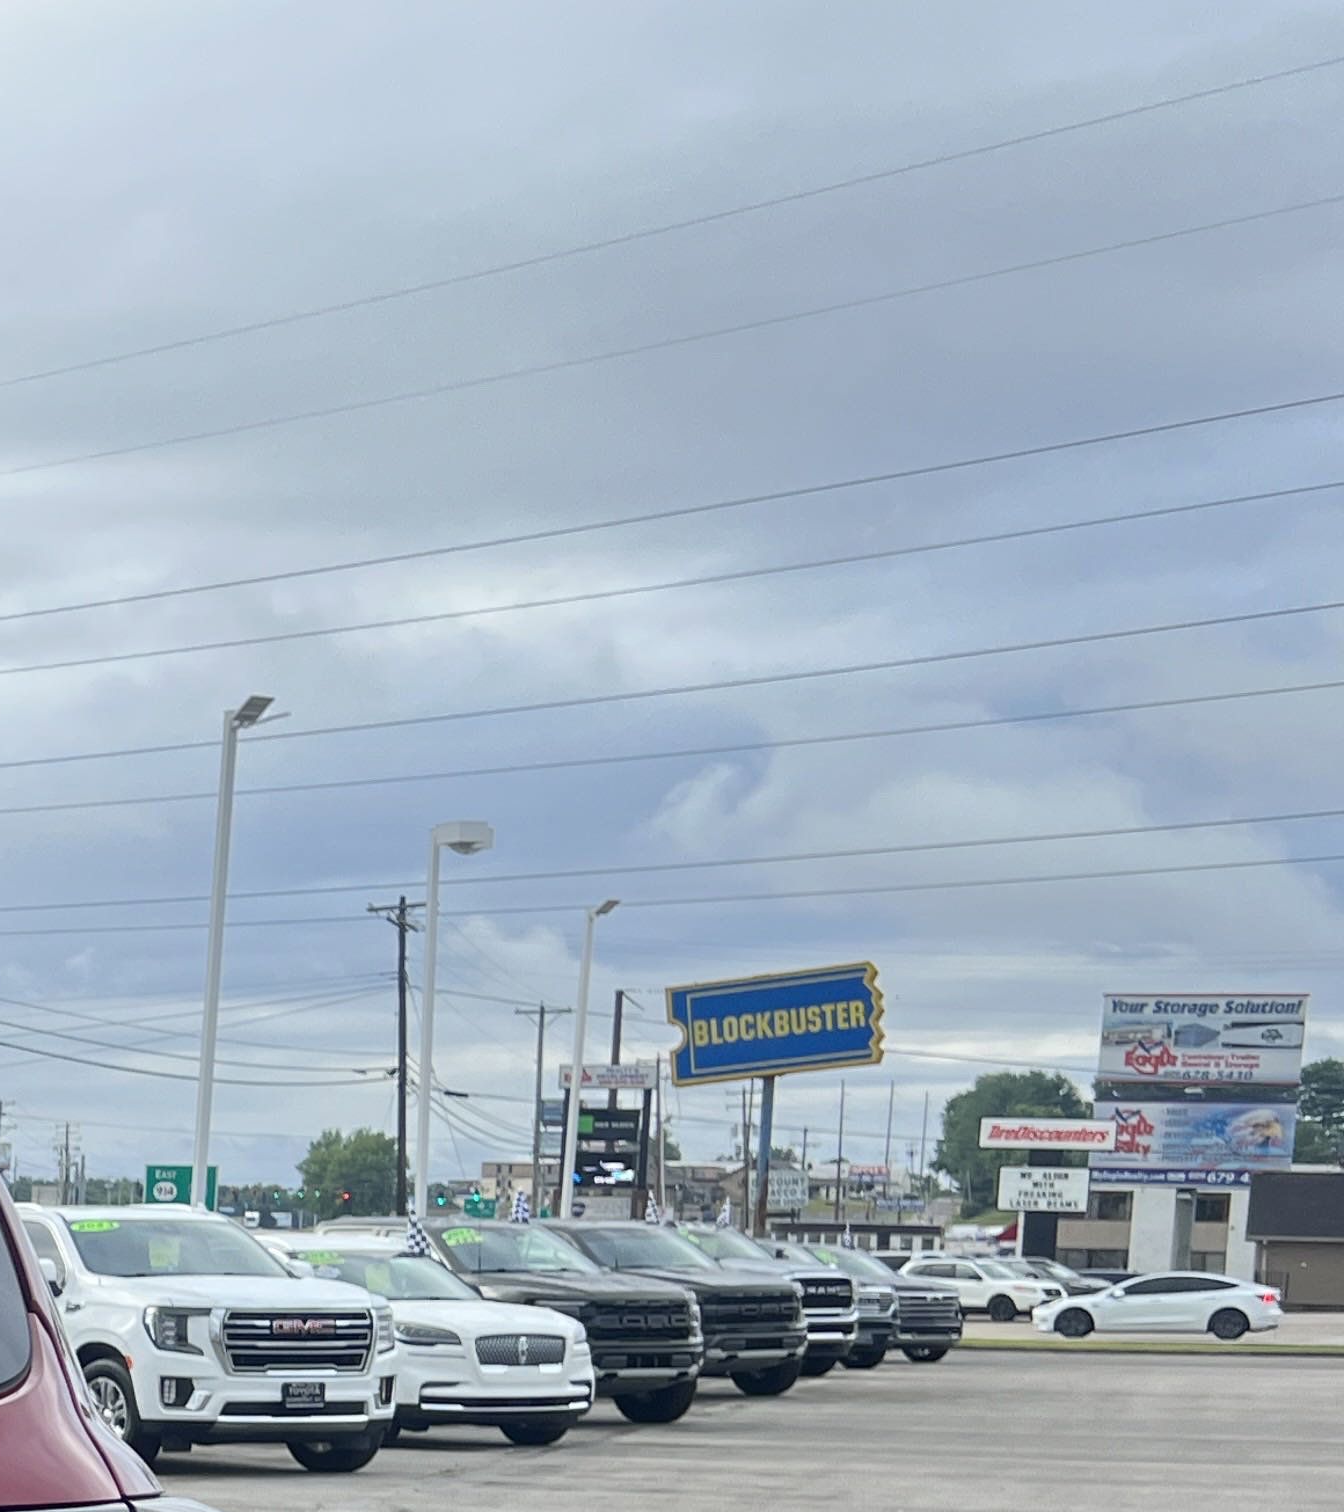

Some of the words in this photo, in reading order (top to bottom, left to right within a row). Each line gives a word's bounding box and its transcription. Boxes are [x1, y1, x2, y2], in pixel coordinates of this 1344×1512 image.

[1112, 1000, 1148, 1014] Your
[1153, 1000, 1220, 1017] Storage
[1223, 1000, 1302, 1015] Solution!
[693, 1000, 866, 1047] BLOCKBUSTER
[155, 1168, 177, 1180] EAST
[272, 1318, 336, 1335] GMC
